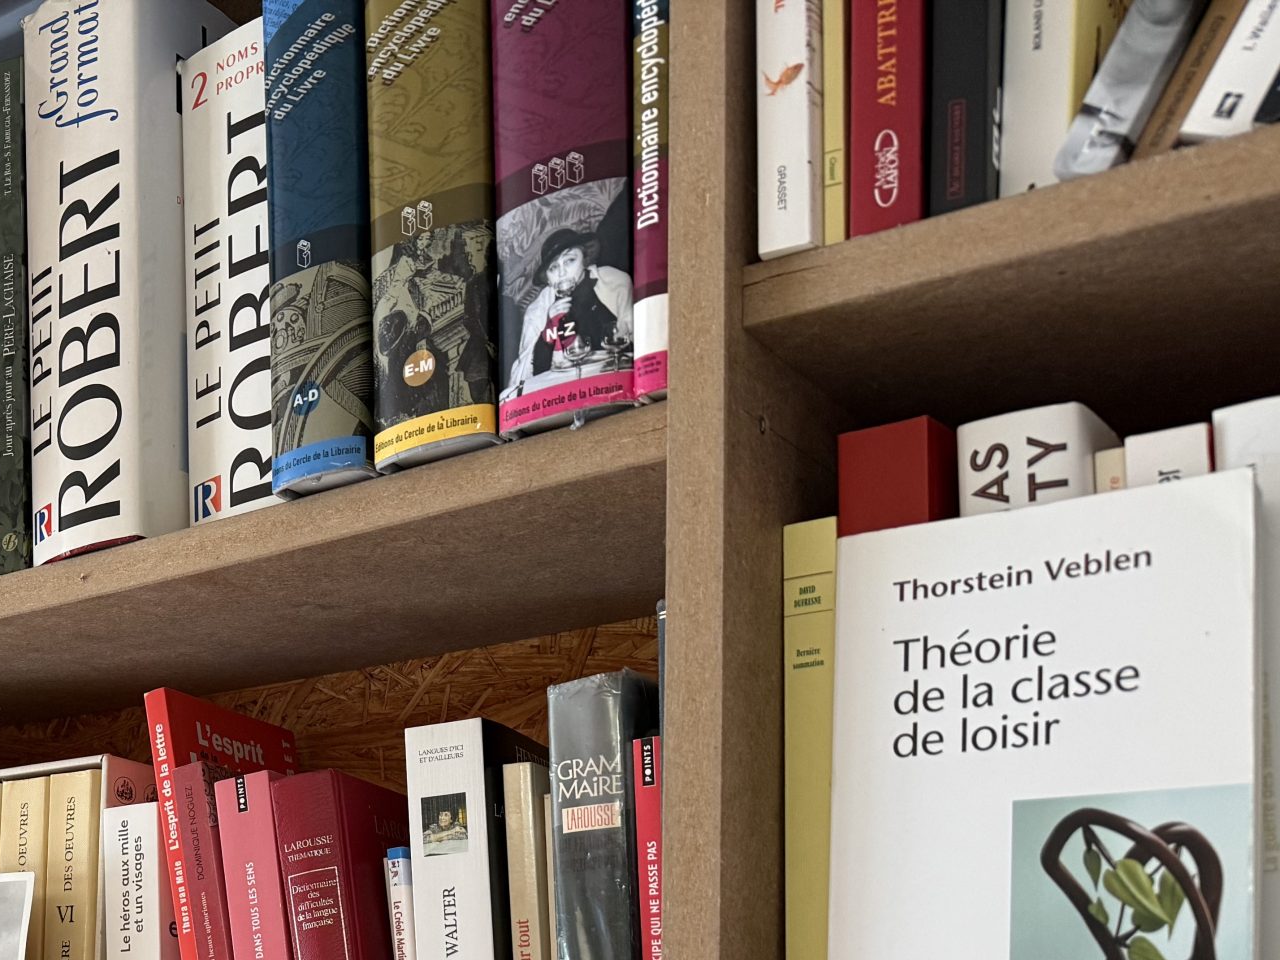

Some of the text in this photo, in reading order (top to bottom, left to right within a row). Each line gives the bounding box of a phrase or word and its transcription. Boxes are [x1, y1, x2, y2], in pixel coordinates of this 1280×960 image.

[37, 10, 70, 121] Grand
[55, 0, 119, 128] format
[215, 41, 259, 74] NOMS
[382, 26, 441, 82] du Livre
[191, 71, 209, 111] 2
[273, 69, 327, 122] du Livre
[636, 107, 660, 230] Dictionnaire
[776, 165, 788, 212] GRASSET
[193, 217, 222, 429] LE PETIT
[226, 109, 272, 509] ROBERT
[545, 321, 576, 342] N-Z
[31, 266, 53, 457] LE PETIT
[57, 149, 123, 533] ROBERT
[403, 356, 434, 378] E-M
[292, 388, 319, 408] A-D
[892, 548, 1154, 603] Thorstein Veblen
[892, 624, 1058, 673] Théorie
[892, 663, 1141, 716] de la classe
[195, 720, 266, 766] L'esprit
[418, 744, 464, 757] LANGUES D'ICI
[428, 752, 464, 763] D'AILLEURS
[892, 711, 1061, 759] de loisir
[557, 753, 622, 782] GRAM
[65, 796, 76, 863] OEUVRES
[566, 804, 617, 831] LAROUSSE
[284, 835, 334, 853] LAROUSSE
[63, 865, 73, 892] DES
[119, 819, 131, 953] Le héros aux mille
[133, 835, 146, 933] et un visages
[291, 878, 338, 895] Dictionnaire
[56, 905, 76, 924] VI
[297, 896, 334, 912] difficultés
[442, 886, 458, 959] WALTER
[515, 919, 531, 948] tout
